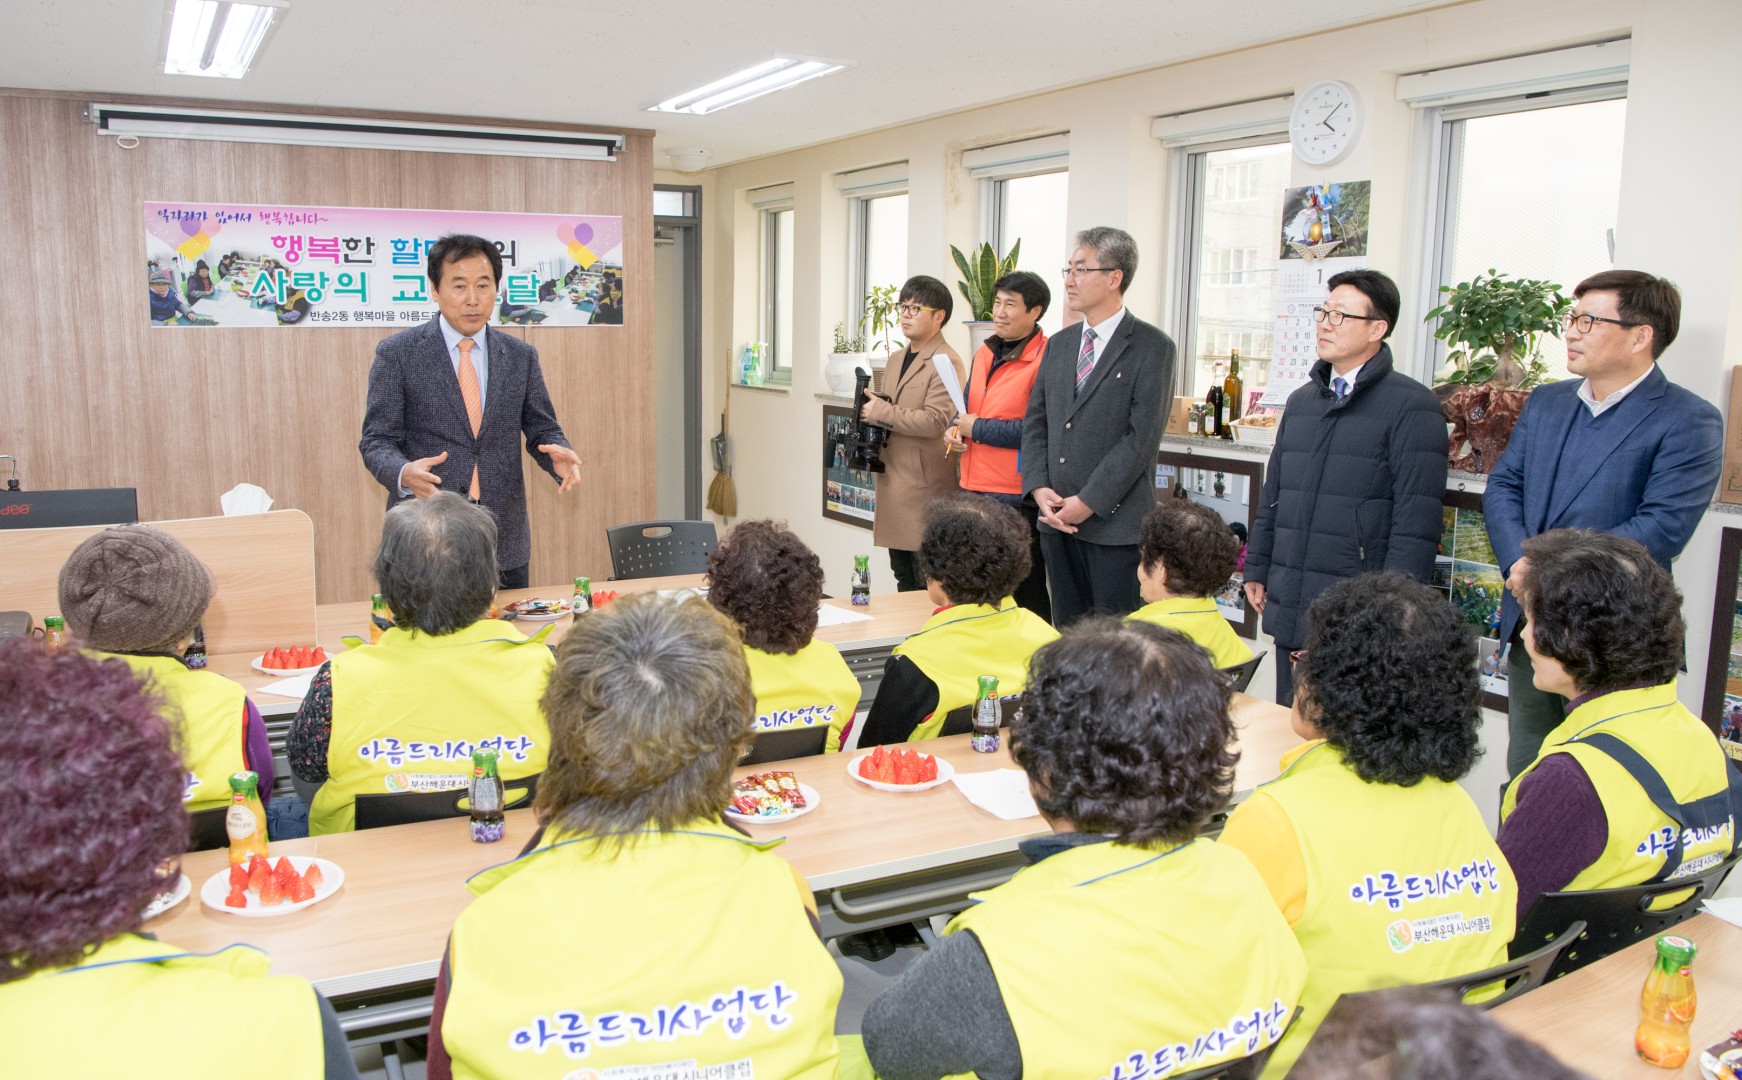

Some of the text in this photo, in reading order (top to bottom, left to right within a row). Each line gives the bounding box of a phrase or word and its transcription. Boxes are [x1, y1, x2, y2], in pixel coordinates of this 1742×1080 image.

[158, 209, 207, 223] 일자리가
[215, 211, 252, 224] 있어서
[271, 235, 375, 264] 행복한
[252, 270, 367, 303] 사랑의
[1317, 268, 1322, 284] 1
[310, 311, 349, 322] 반송2동
[353, 311, 395, 322] 행복마을
[1290, 358, 1296, 366] 23
[751, 705, 837, 729] 리사업단
[1352, 859, 1497, 908] 아름드리사업단
[1414, 923, 1455, 942] 부산해운대
[1456, 916, 1490, 933] 시니어클럽
[515, 985, 792, 1053] 아름드리사업단
